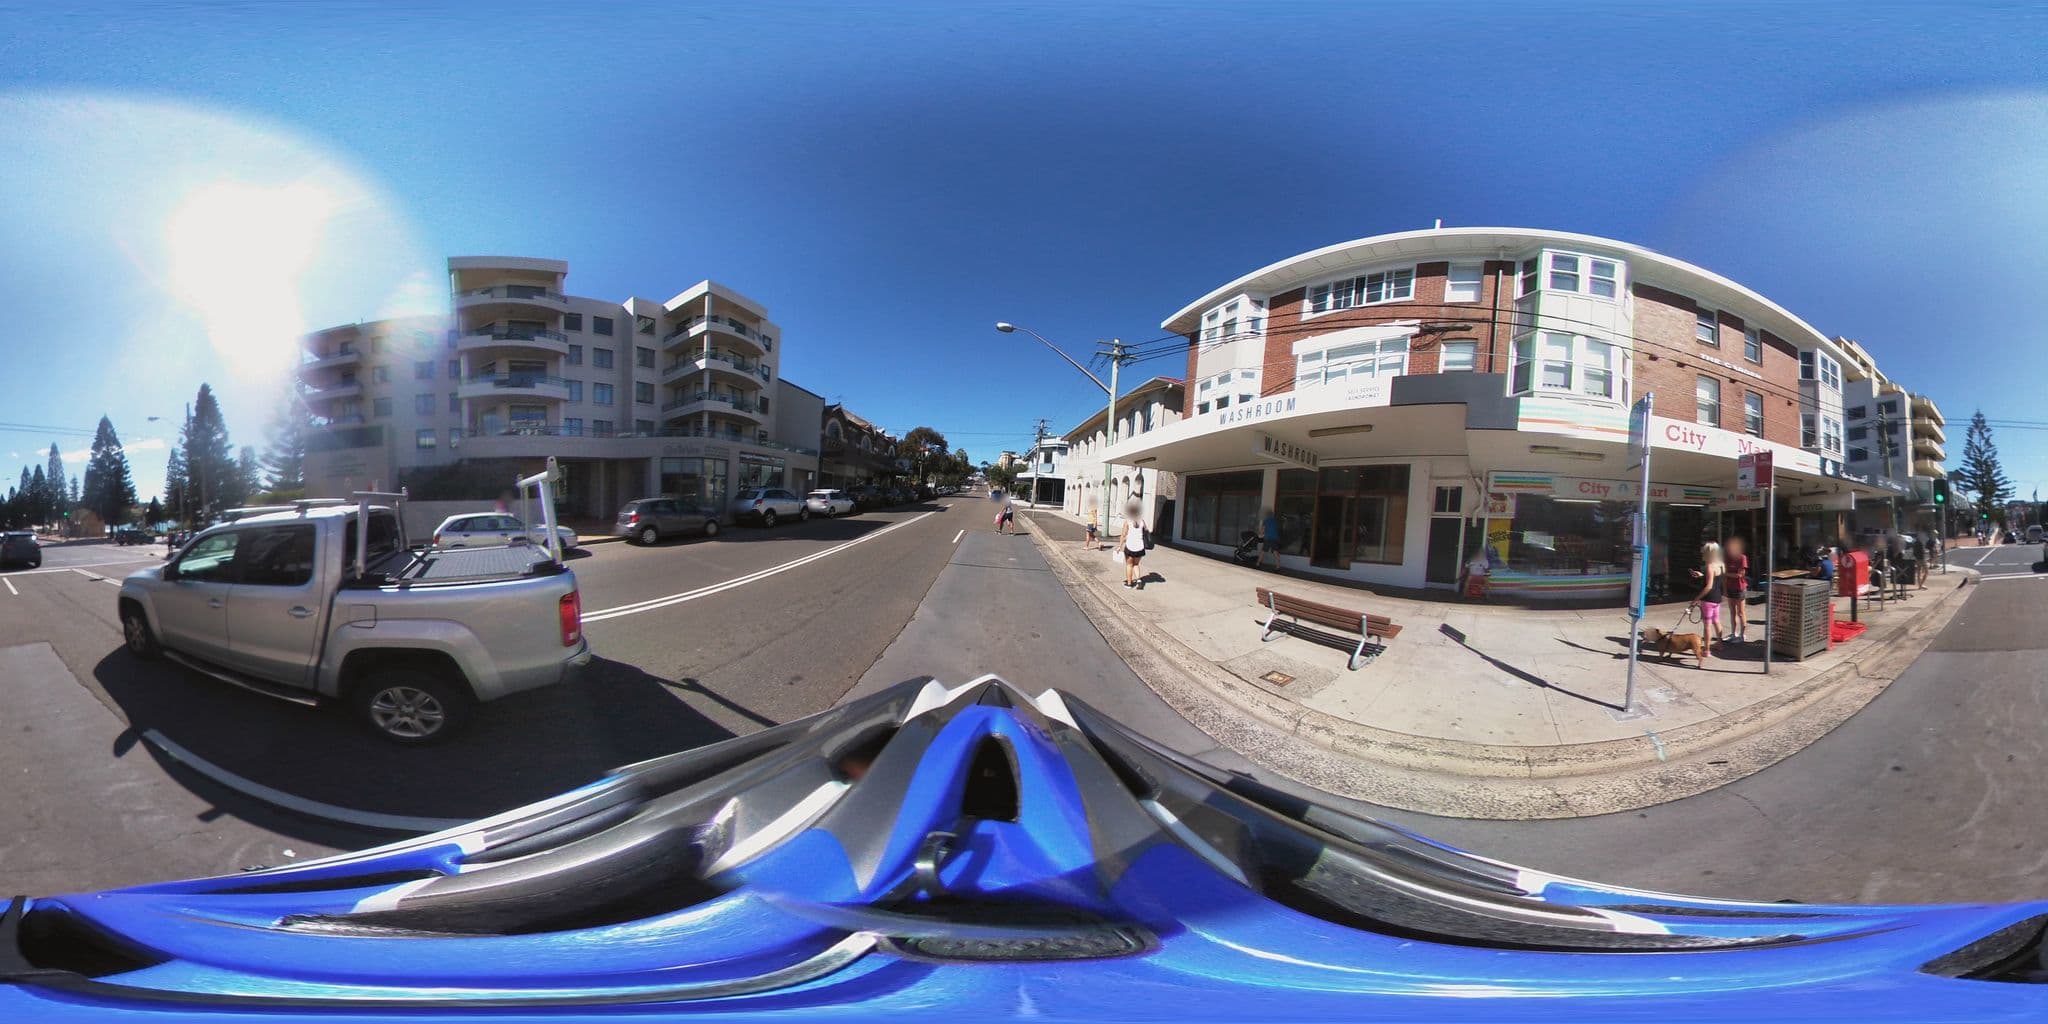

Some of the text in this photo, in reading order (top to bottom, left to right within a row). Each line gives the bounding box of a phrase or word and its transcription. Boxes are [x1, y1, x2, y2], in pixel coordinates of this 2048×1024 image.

[1219, 397, 1296, 425] WASHROOM
[1665, 424, 1707, 450] City
[1264, 436, 1318, 466] WASHROOM
[1579, 481, 1611, 497] City
